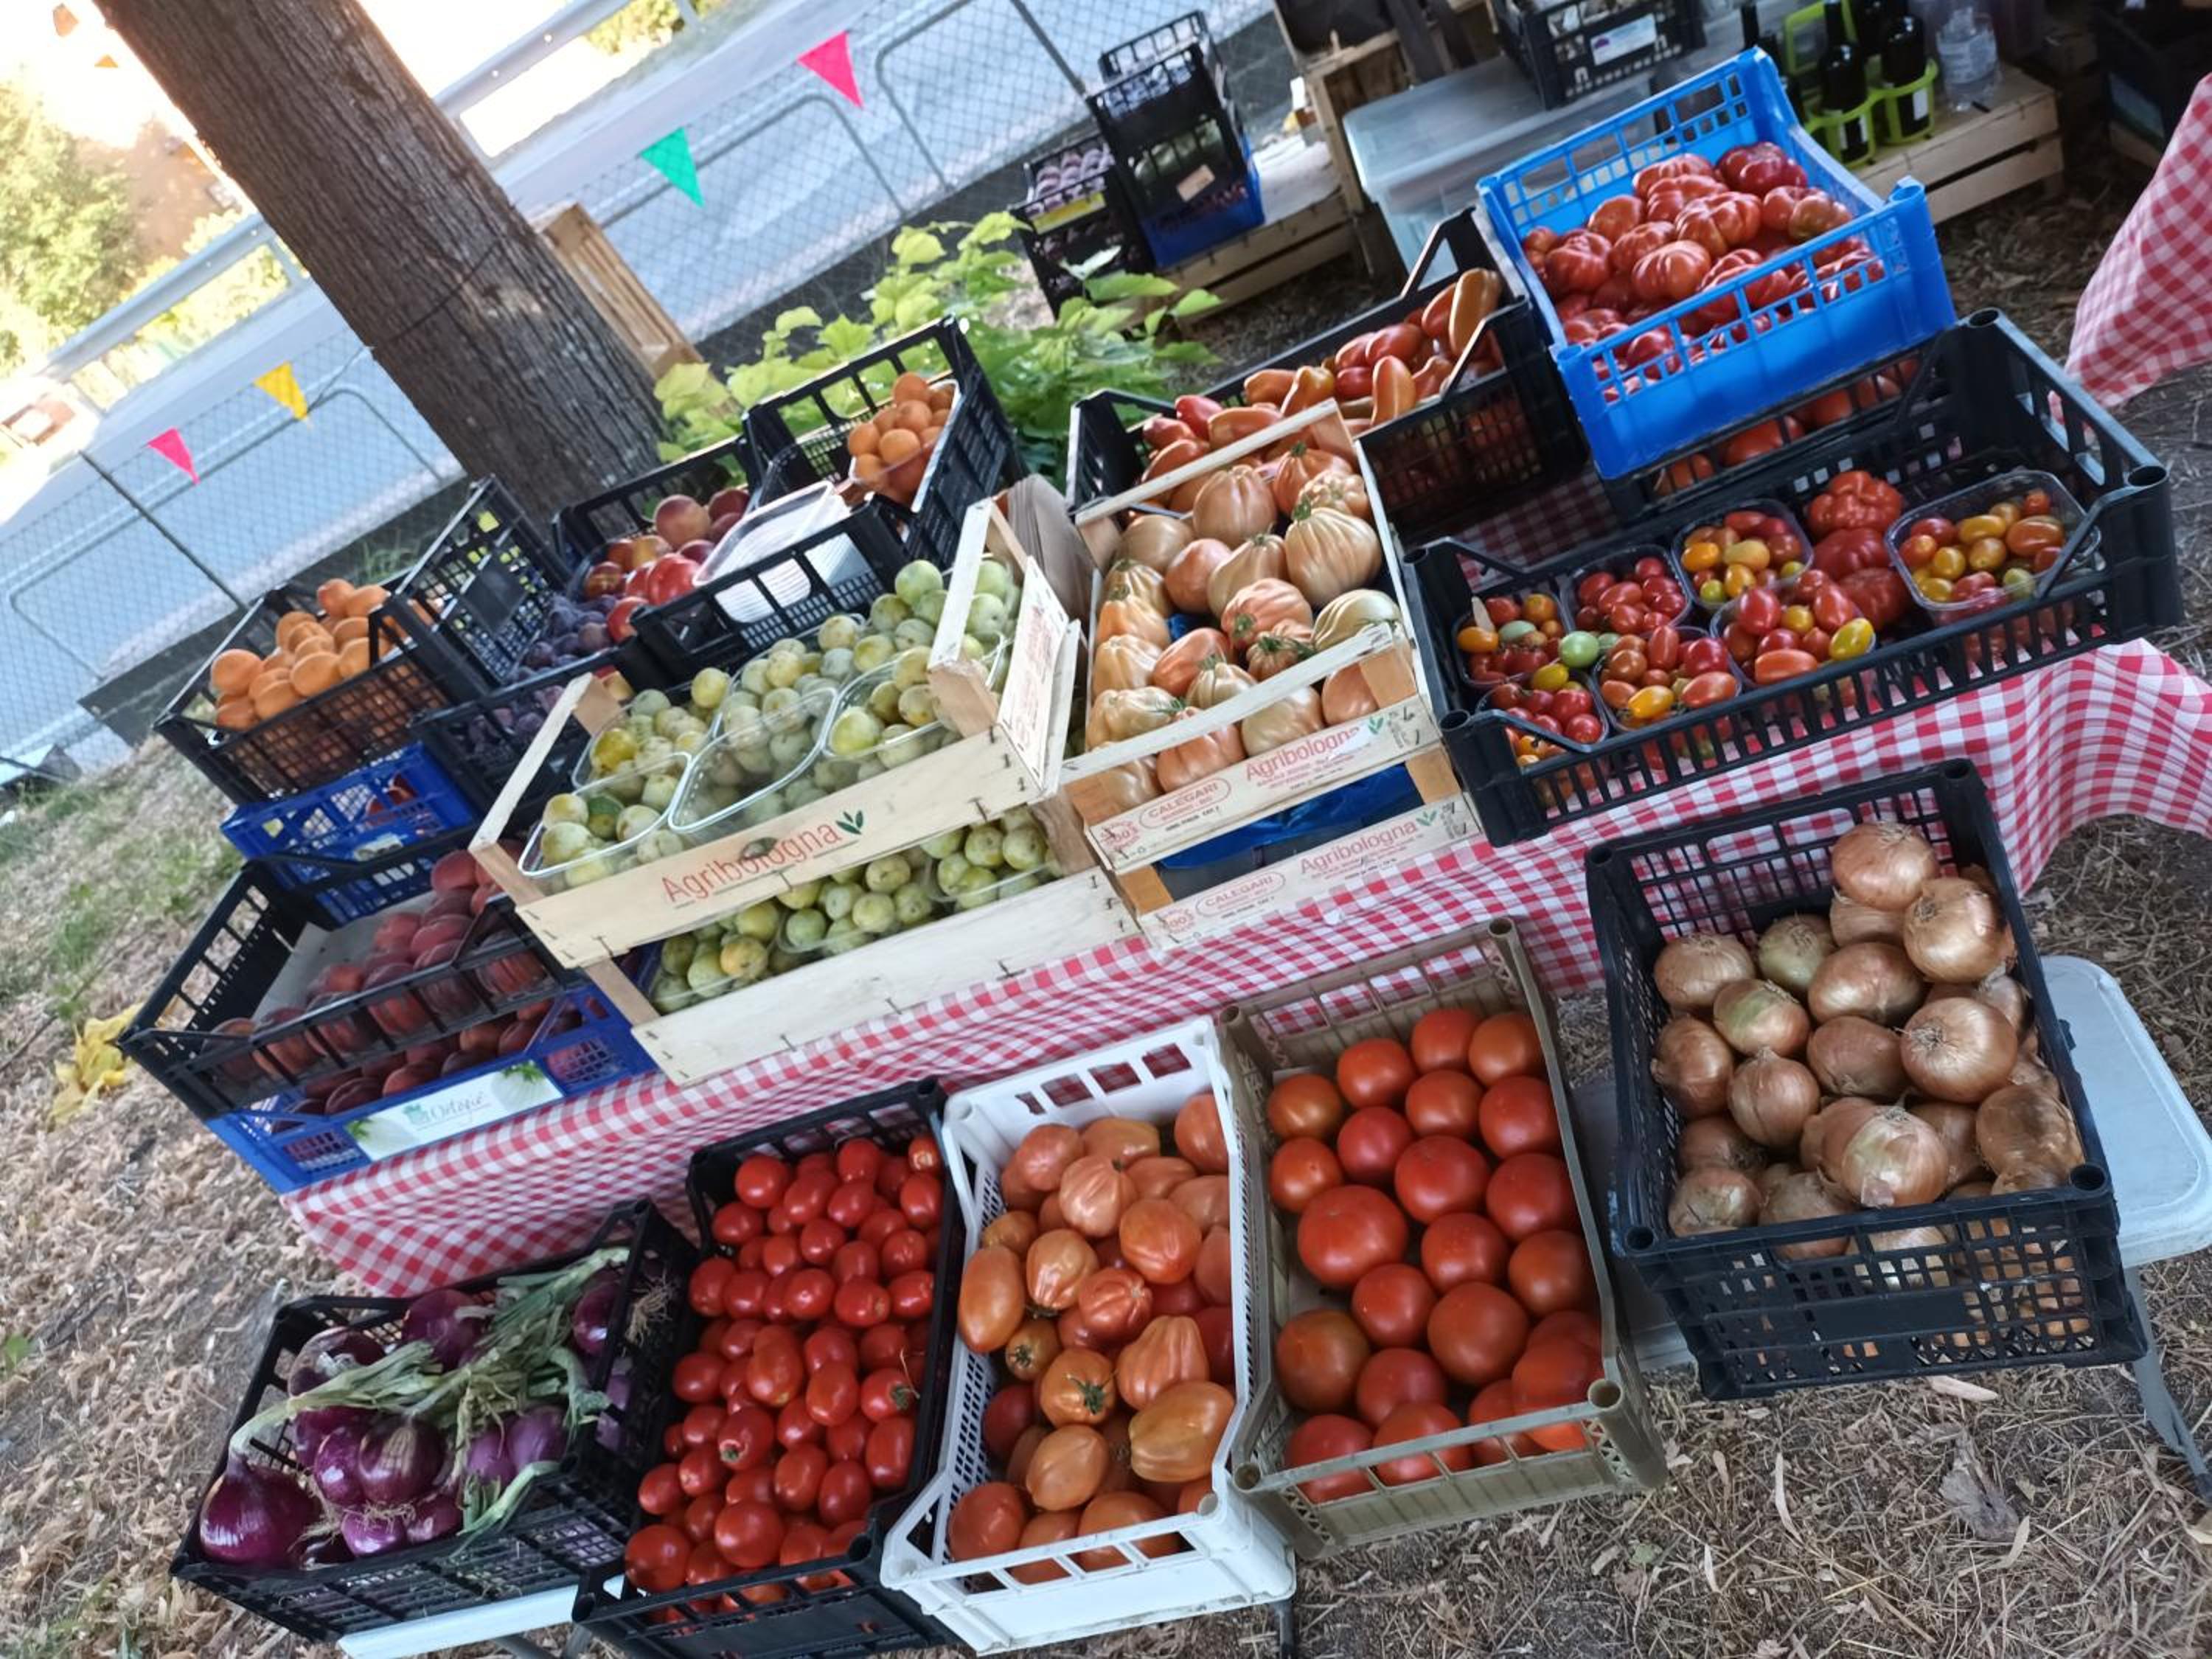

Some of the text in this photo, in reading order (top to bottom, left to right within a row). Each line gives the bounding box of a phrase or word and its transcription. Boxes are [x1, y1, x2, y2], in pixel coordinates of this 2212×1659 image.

[1148, 782, 1219, 818] CALEGARI
[1300, 820, 1418, 874] Agribologna
[1205, 875, 1274, 906] CALEGARI
